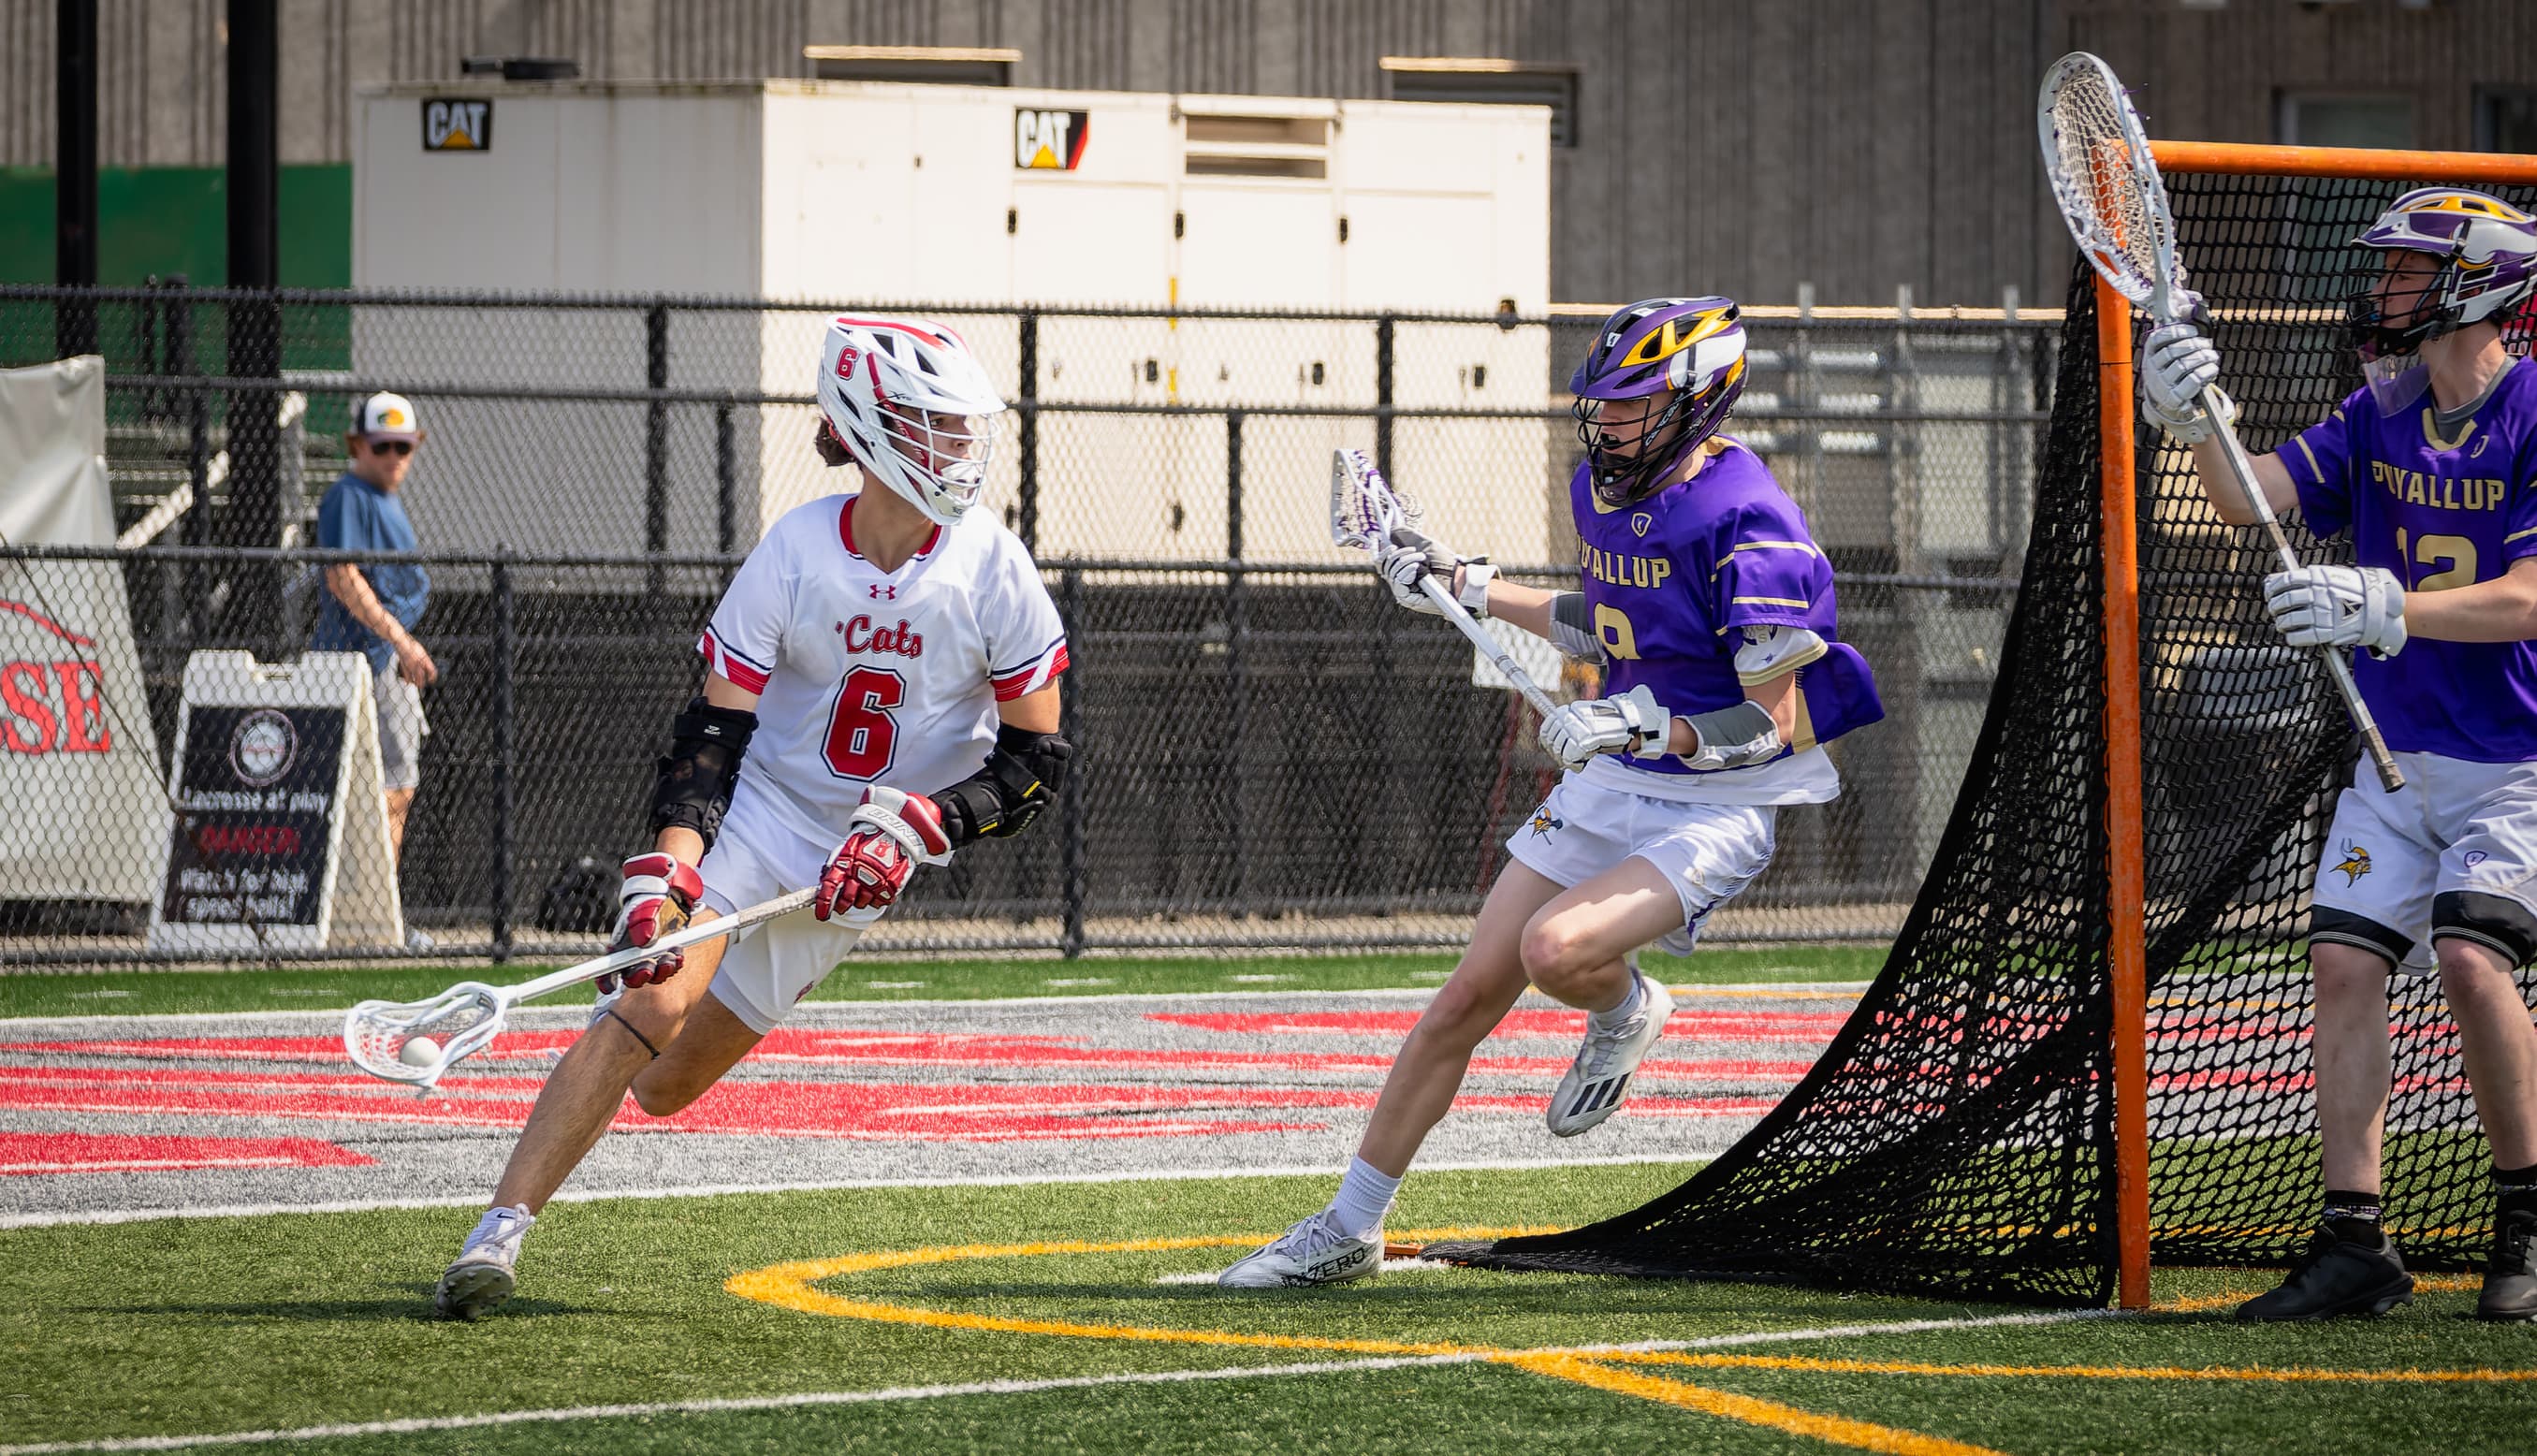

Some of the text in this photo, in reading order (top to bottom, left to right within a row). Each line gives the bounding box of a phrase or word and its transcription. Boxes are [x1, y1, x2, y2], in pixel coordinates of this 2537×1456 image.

[428, 102, 488, 147] CAT
[1017, 111, 1071, 168] CAT
[835, 344, 861, 381] 6
[0, 660, 110, 755] SE
[820, 663, 906, 782] 6
